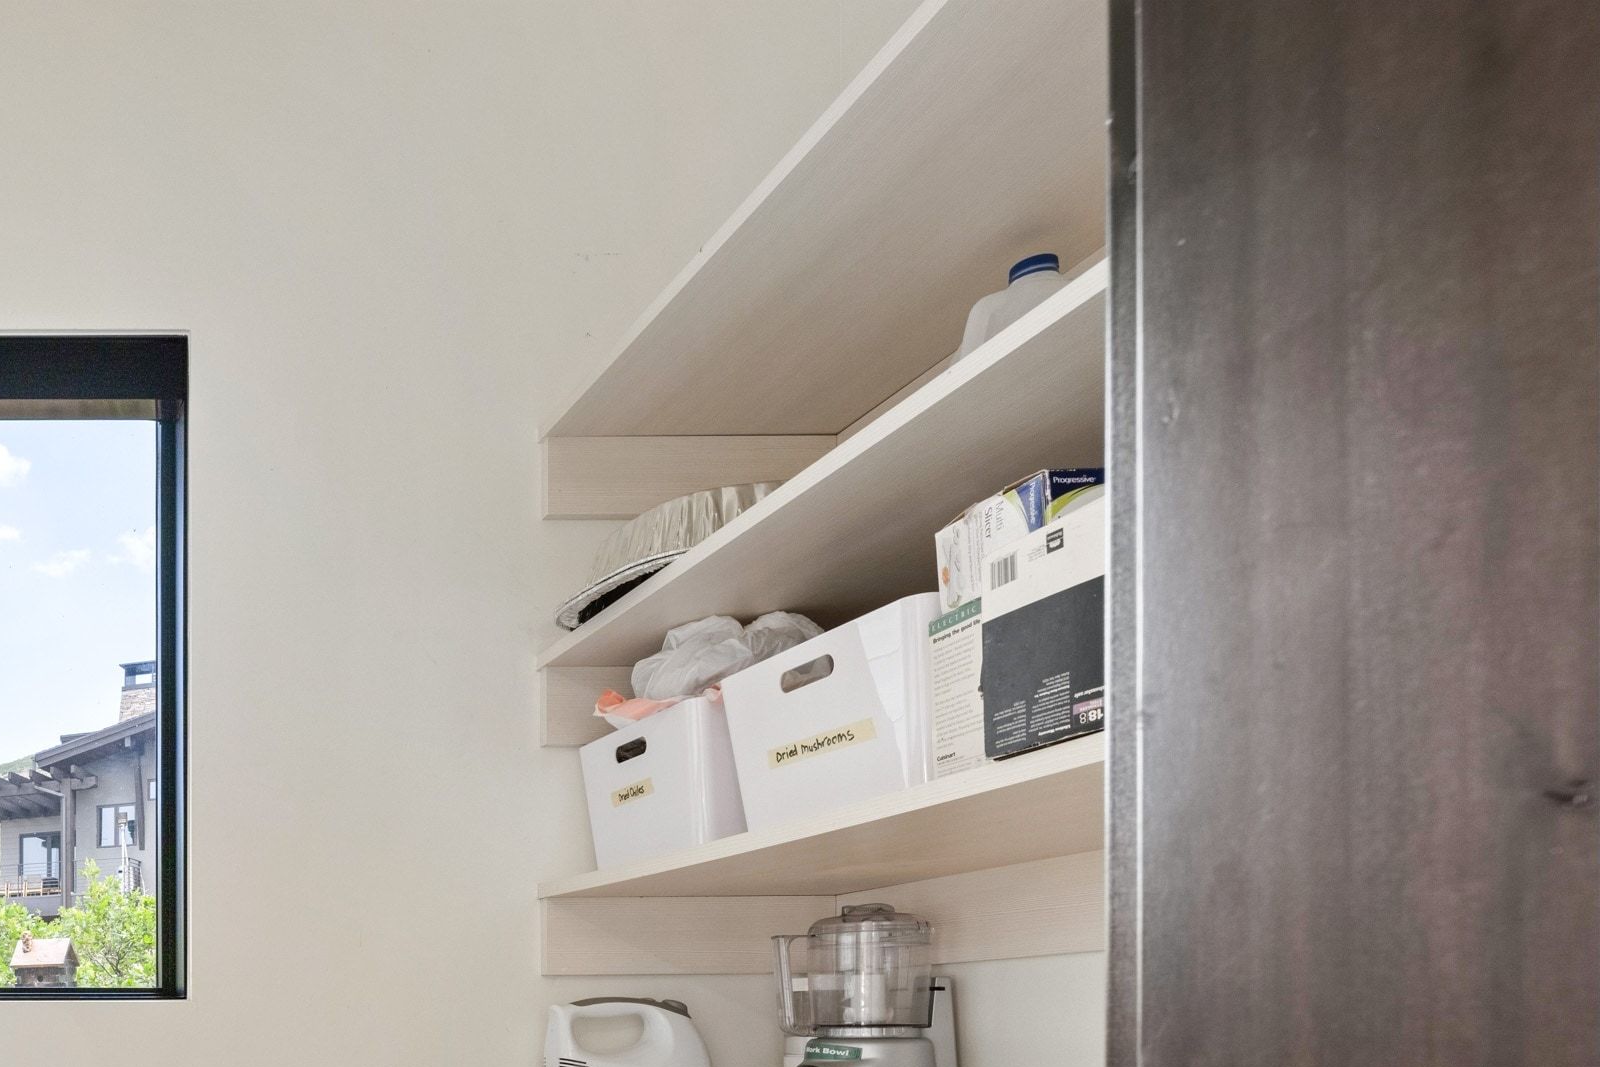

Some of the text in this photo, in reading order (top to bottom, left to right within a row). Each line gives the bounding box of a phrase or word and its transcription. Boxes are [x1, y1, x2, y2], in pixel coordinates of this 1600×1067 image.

[1052, 474, 1096, 484] Progressive
[984, 506, 993, 539] Slicer
[995, 500, 1005, 532] Multi
[931, 605, 977, 633] ELECTRIC
[933, 633, 951, 644] Bringing
[776, 748, 798, 763] Dried
[822, 1047, 850, 1057] Bowl
